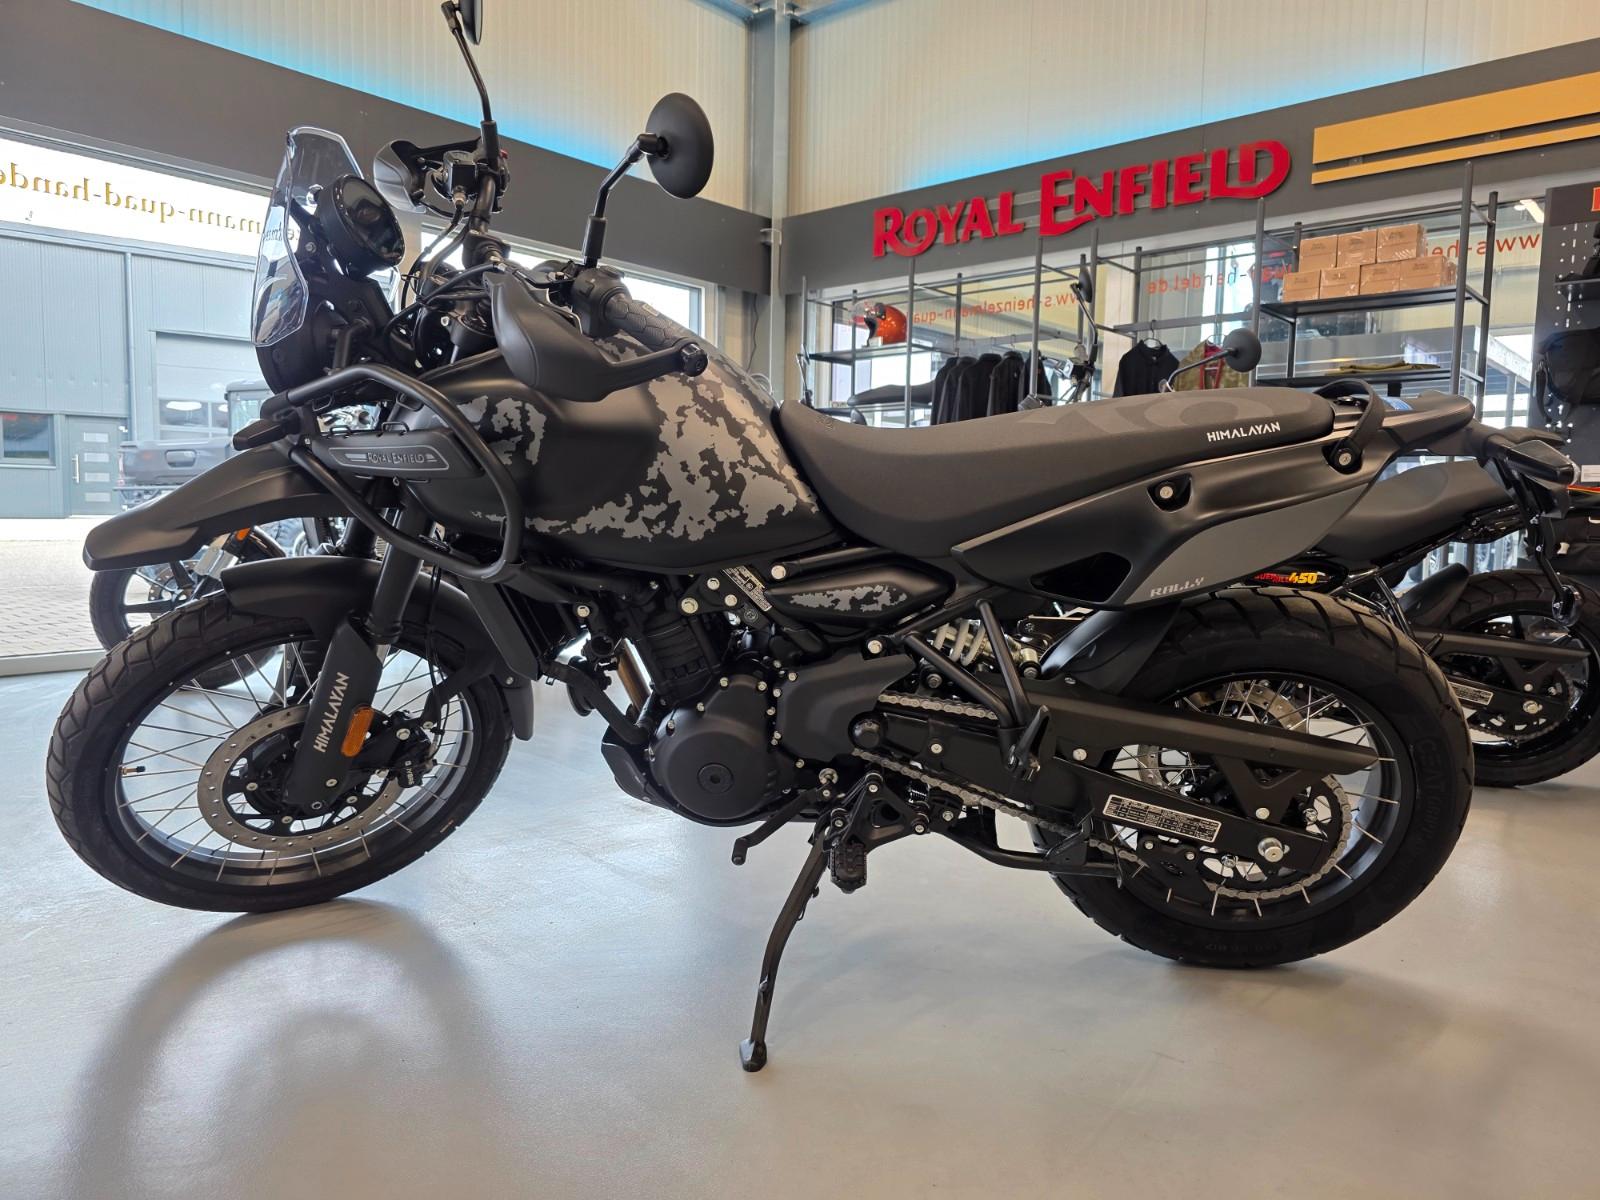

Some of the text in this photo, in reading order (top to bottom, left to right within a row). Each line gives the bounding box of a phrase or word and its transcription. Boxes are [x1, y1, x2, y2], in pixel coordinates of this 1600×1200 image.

[872, 139, 1292, 258] ROYAL ENFIELD
[1206, 421, 1281, 442] HIMALAYAN
[367, 452, 425, 464] ROYAL ENFIELD
[1150, 576, 1205, 598] RALLY
[1288, 571, 1318, 585] 450
[313, 671, 350, 753] HIMALAYAN
